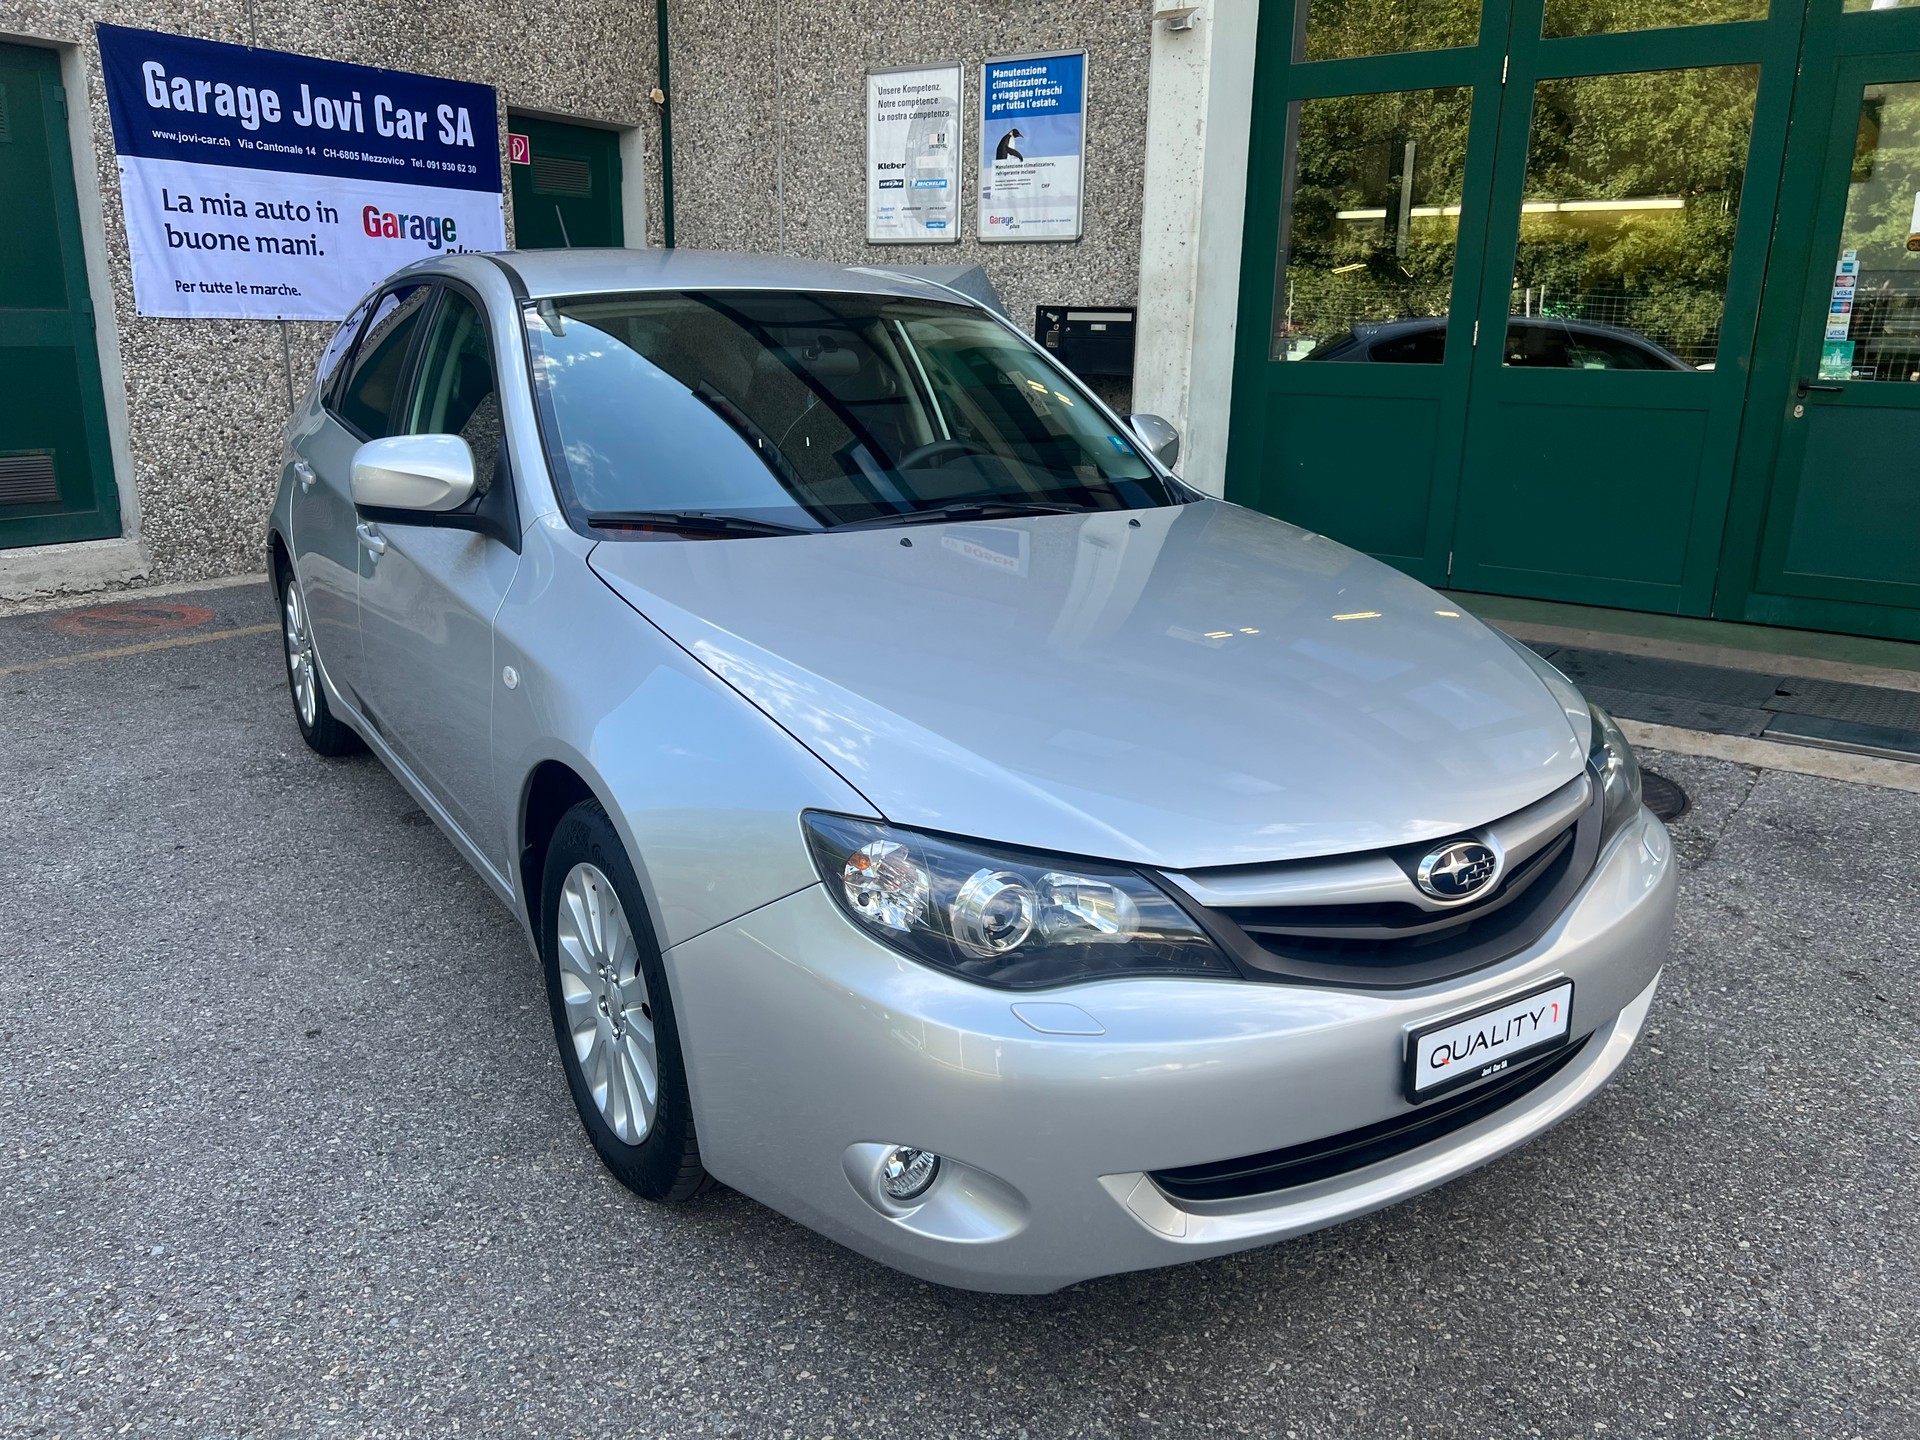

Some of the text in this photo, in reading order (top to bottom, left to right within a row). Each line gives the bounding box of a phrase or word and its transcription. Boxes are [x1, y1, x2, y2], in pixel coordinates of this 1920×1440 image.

[992, 66, 1047, 78] Manutenzione
[878, 84, 941, 95] Unsere Kompetenz.
[998, 88, 1034, 100] viaggiate
[1035, 86, 1062, 96] freschi
[142, 61, 475, 147] Garage Jovi Car SA
[878, 97, 940, 108] Notre compétence.
[992, 103, 1005, 113] per
[1006, 101, 1025, 109] tutta
[878, 110, 951, 121] La nostra competenza.
[152, 130, 476, 174] www.jovi-car.ch Via Cantonale 14 CH-6805 Mezzovico Tel. 091 930 62 30
[878, 162, 906, 170] Kleber
[162, 188, 339, 224] La mia auto in
[362, 206, 456, 250] Garage
[990, 216, 1014, 226] Garage
[164, 223, 324, 256] buone mani.
[175, 280, 301, 296] Per tutte le marche.
[1430, 1002, 1559, 1069] QUALITY 1
